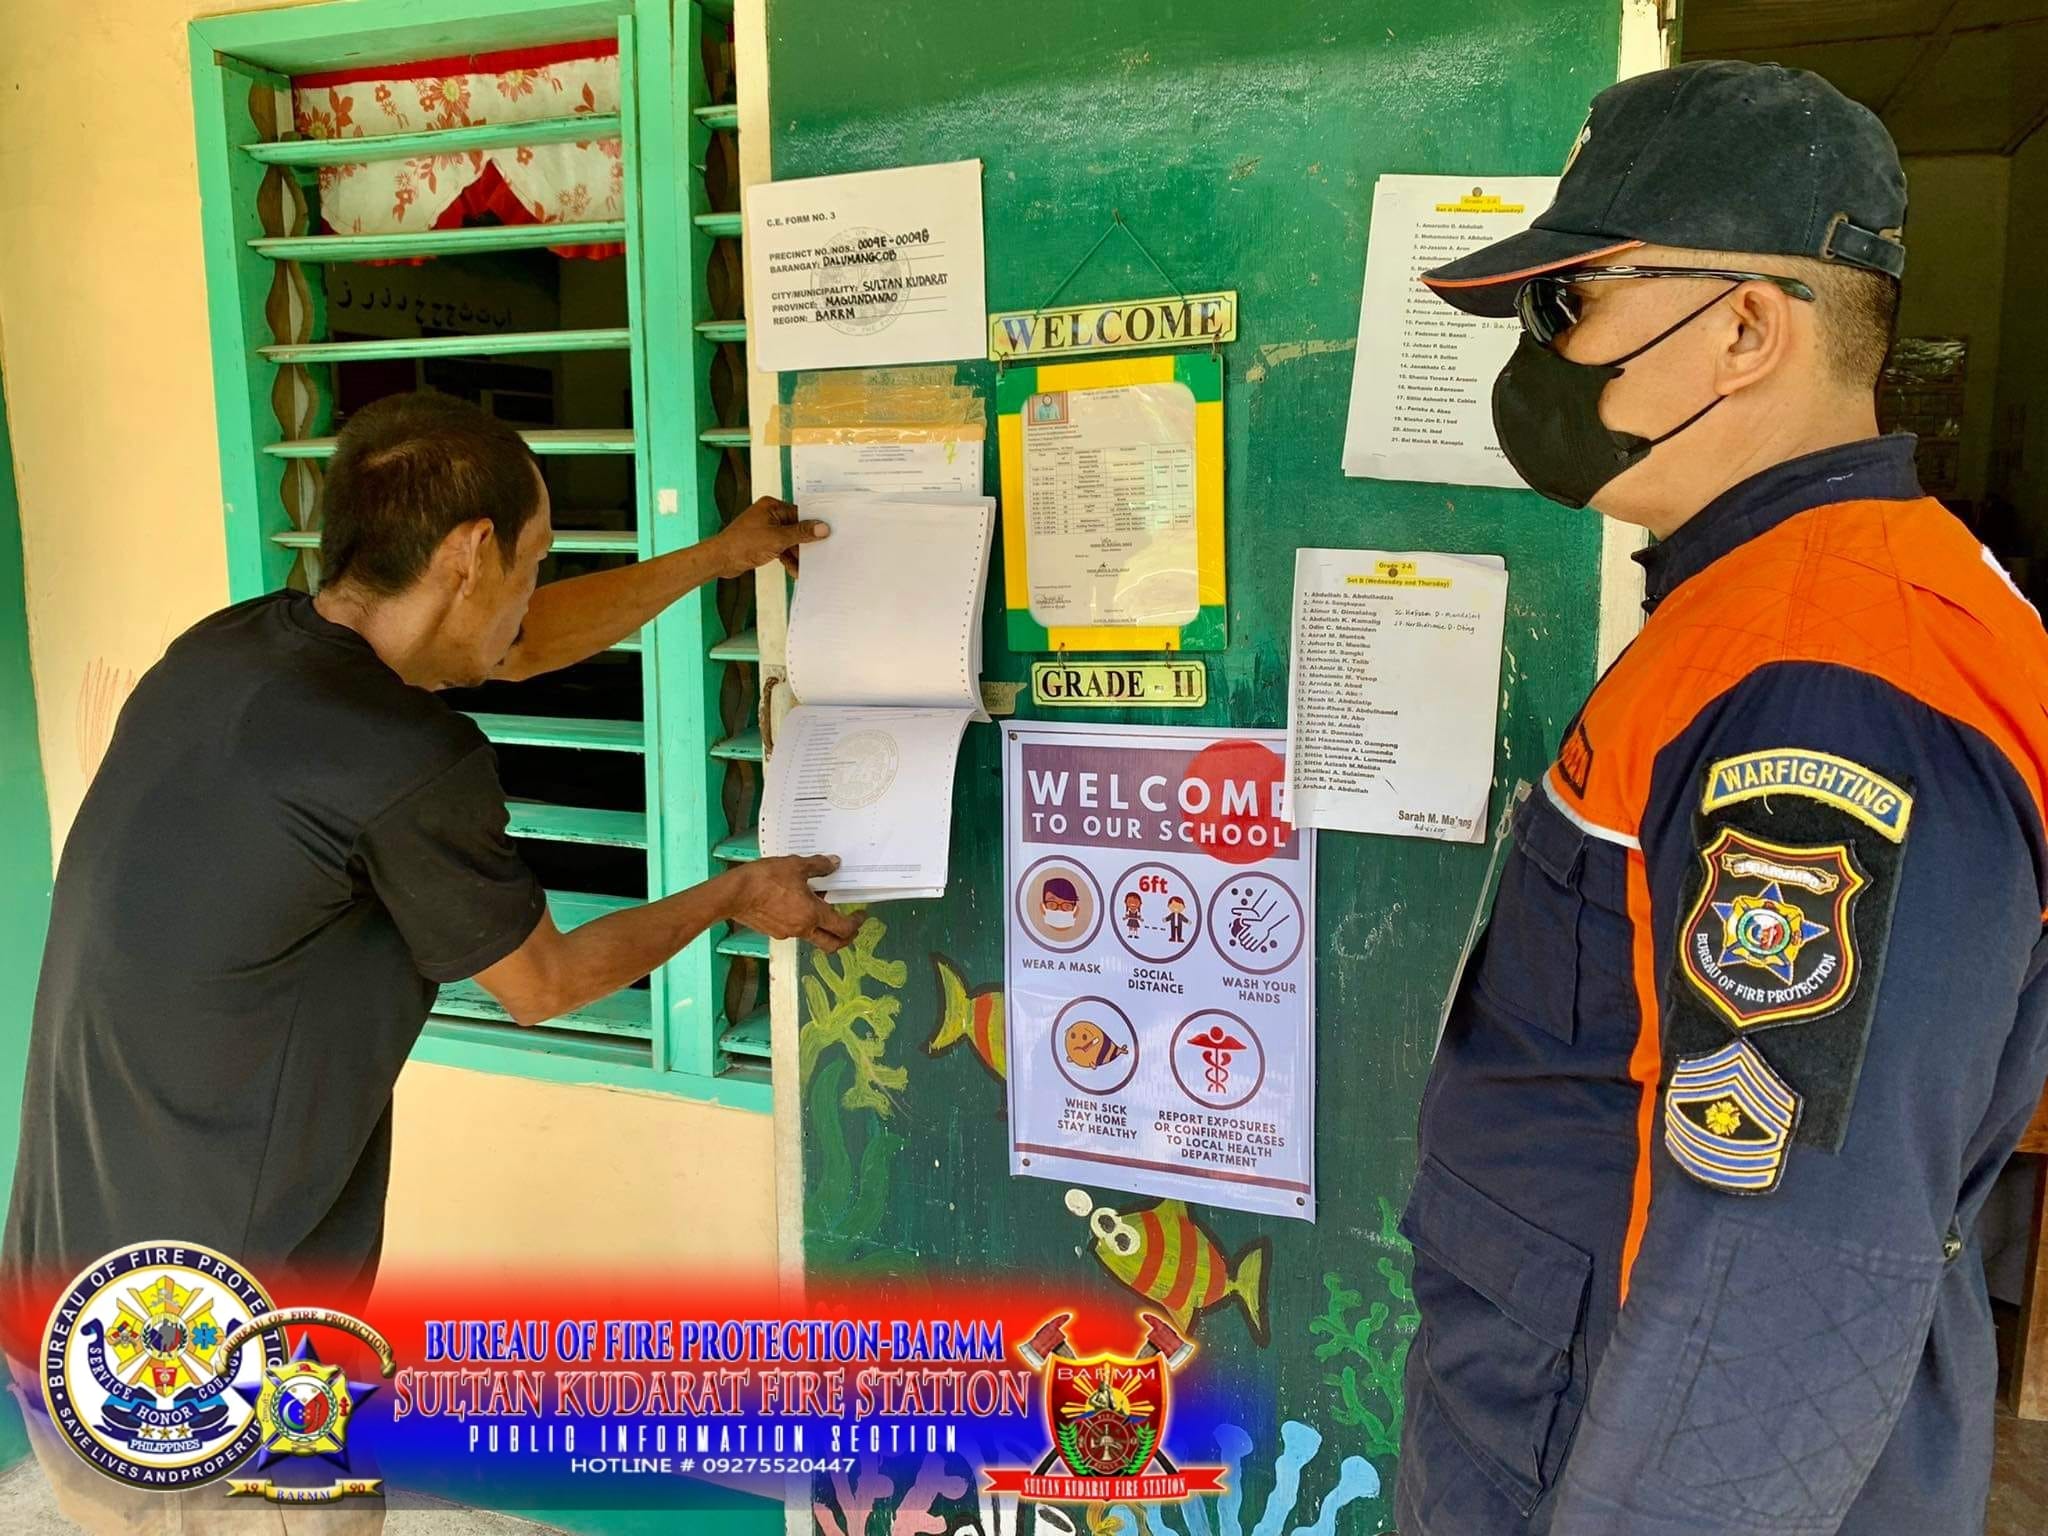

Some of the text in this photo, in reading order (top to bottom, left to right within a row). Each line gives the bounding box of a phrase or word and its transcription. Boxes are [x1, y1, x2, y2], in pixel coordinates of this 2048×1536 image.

[786, 215, 810, 224] FORM
[830, 211, 836, 220] 3
[769, 249, 812, 261] PRECINCT
[863, 277, 902, 292] SULTAN
[906, 273, 948, 288] KUDARAT
[1002, 300, 1223, 353] WELCOME
[1042, 670, 1146, 698] GRADE
[1721, 759, 1896, 815] WARFIGHTING
[1398, 810, 1425, 822] Sarah
[1428, 812, 1439, 824] M.
[1032, 813, 1286, 848] TO OUR SCHOOL
[1139, 875, 1168, 894] 6ft
[1022, 958, 1101, 974] WEAR A MASK
[1133, 968, 1174, 981] SOCIAL
[1696, 932, 1836, 1004] BUREAU OF FIRE PROTECTION
[1128, 979, 1184, 994] DISTANCE
[1222, 976, 1297, 994] WASH YOUR
[1239, 990, 1281, 1004] HANDS
[1065, 1097, 1127, 1115] WHEN SICK
[1064, 1109, 1127, 1126] STAY HOME
[1158, 1110, 1276, 1134] REPORT EXPOSURES
[1057, 1119, 1137, 1140] STAY HEALTHY
[1154, 1121, 1285, 1148] OR CONFIRMED CASES
[1167, 1134, 1273, 1158] TO LOCAL HEALTH
[1181, 1148, 1257, 1168] DEPARTMENT
